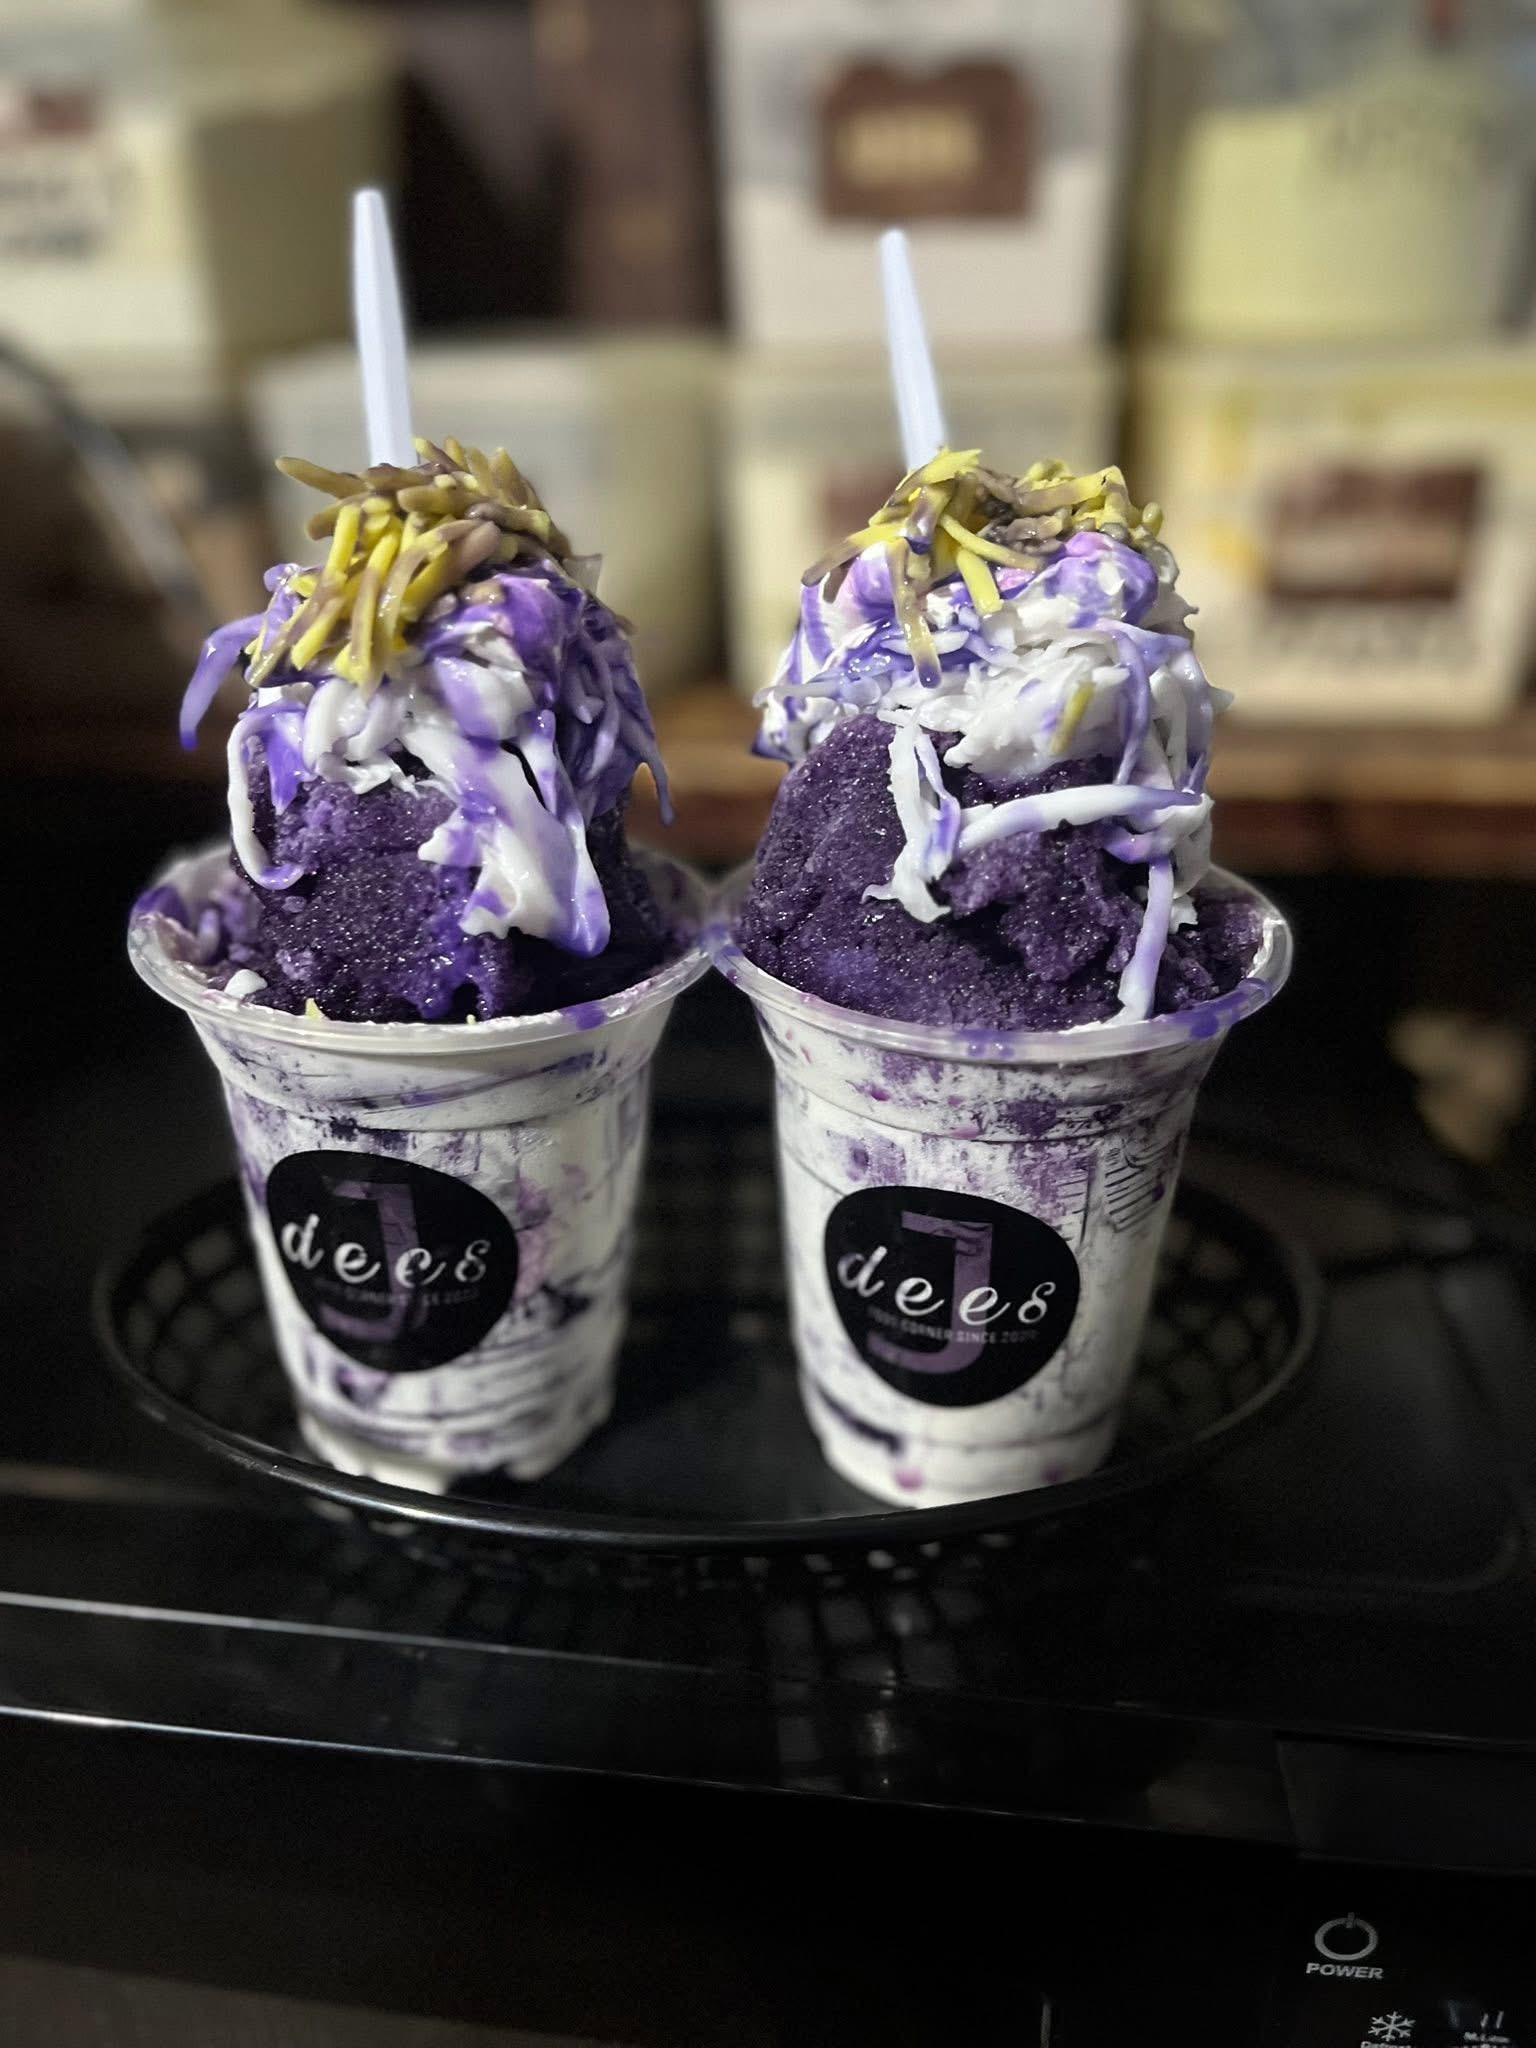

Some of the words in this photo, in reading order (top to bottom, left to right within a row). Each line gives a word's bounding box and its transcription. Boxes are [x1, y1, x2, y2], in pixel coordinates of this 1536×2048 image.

[281, 1213, 491, 1288] dees
[837, 1245, 1056, 1326] dees
[956, 1330, 996, 1344] SINCE
[1306, 1962, 1384, 1979] POWER
